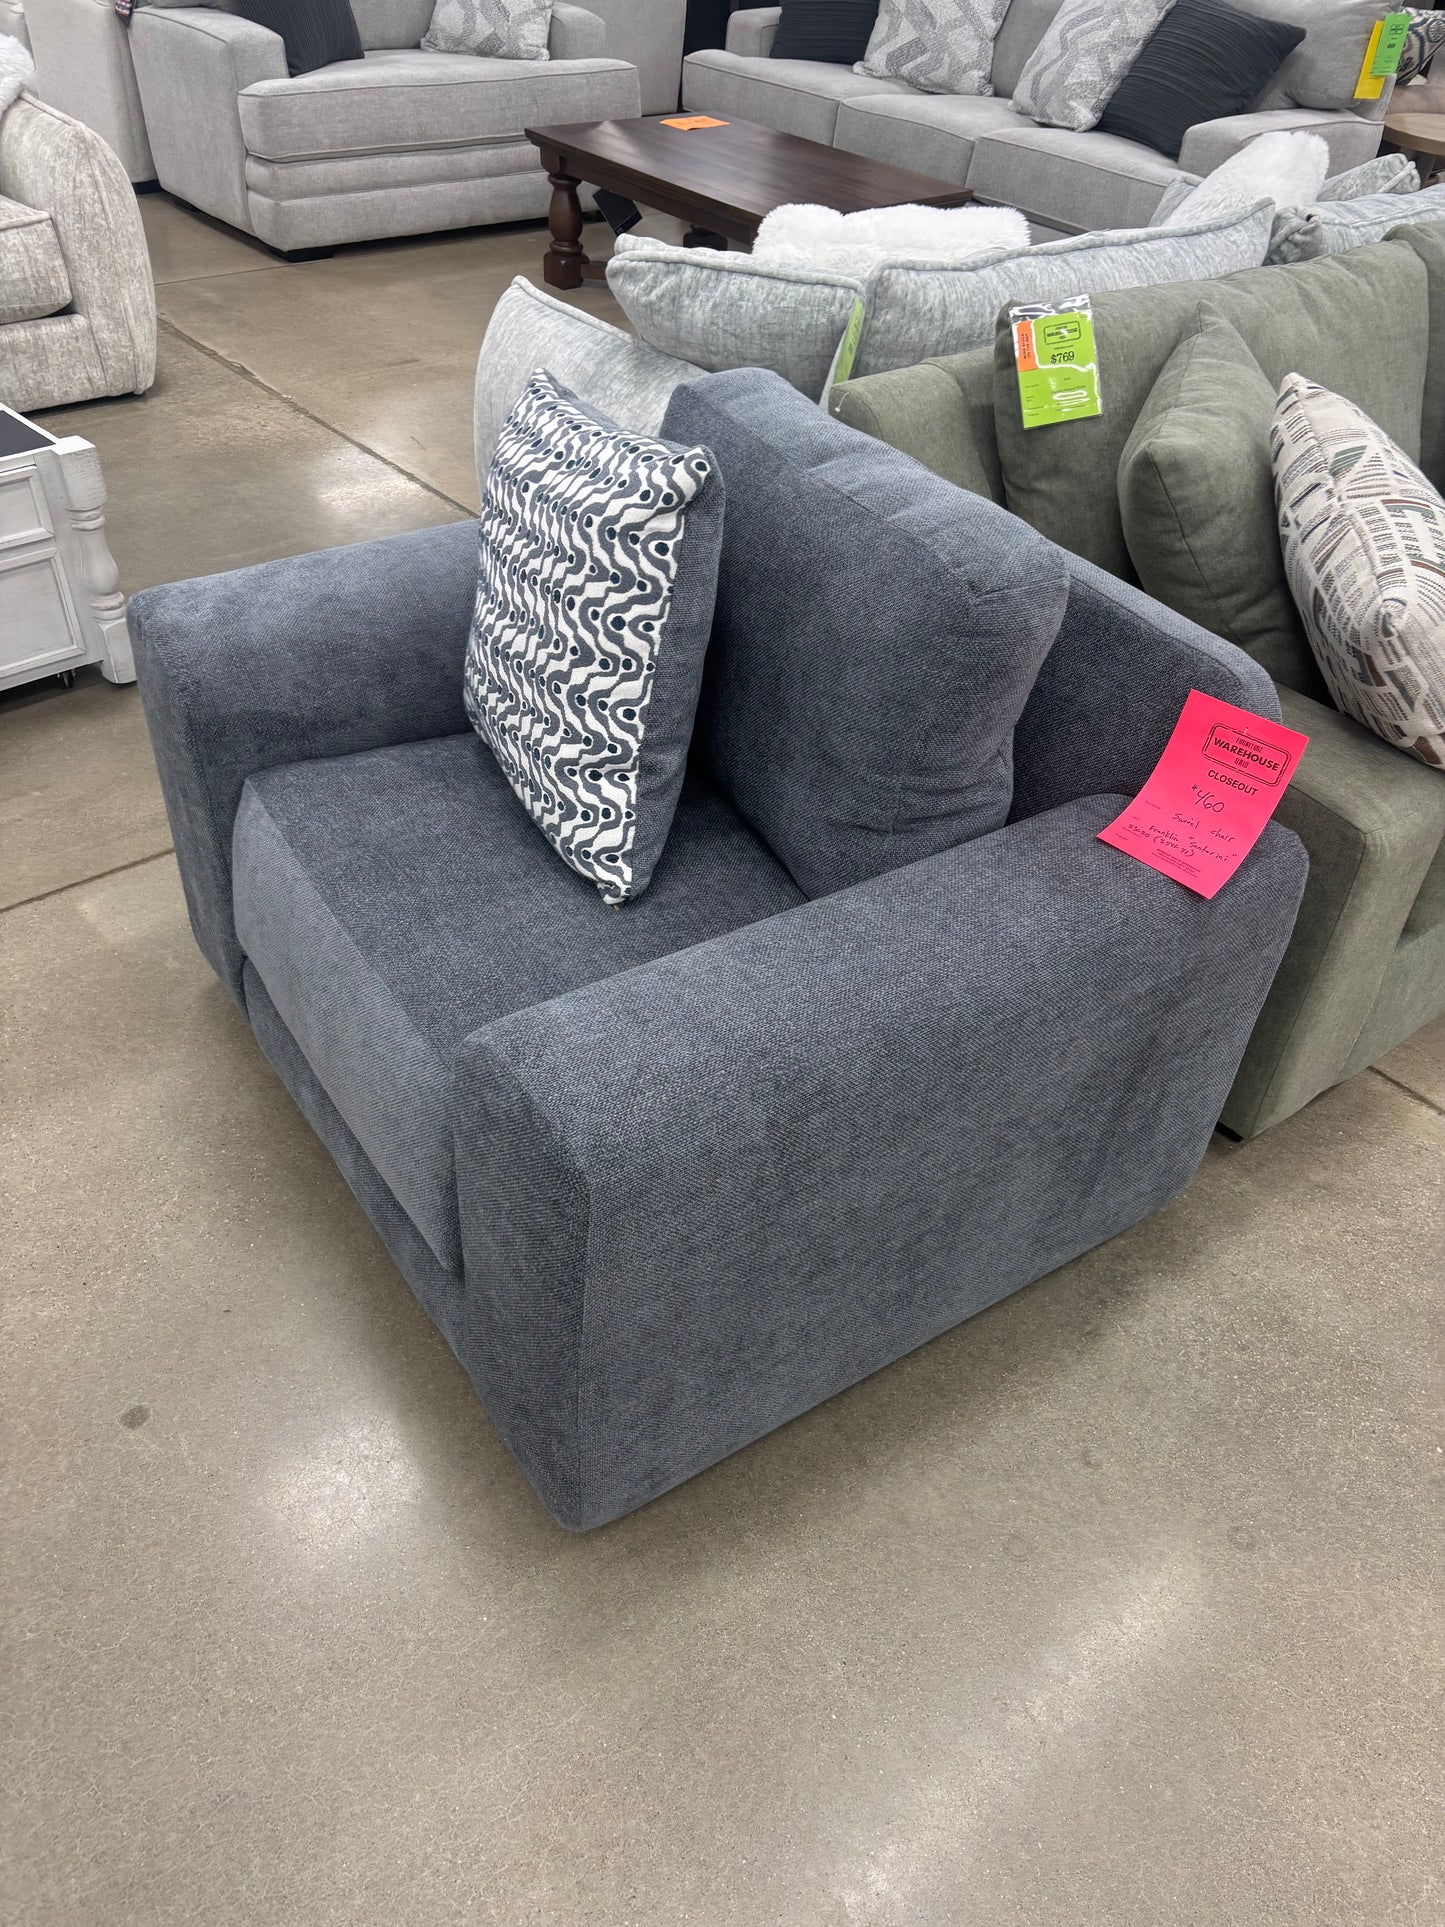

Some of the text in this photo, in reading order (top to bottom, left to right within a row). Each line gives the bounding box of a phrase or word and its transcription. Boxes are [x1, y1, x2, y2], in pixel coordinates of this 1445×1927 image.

[1050, 350, 1075, 364] $769
[1213, 737, 1280, 771] WAREHOUSE
[1207, 769, 1259, 796] CLOSEOUT
